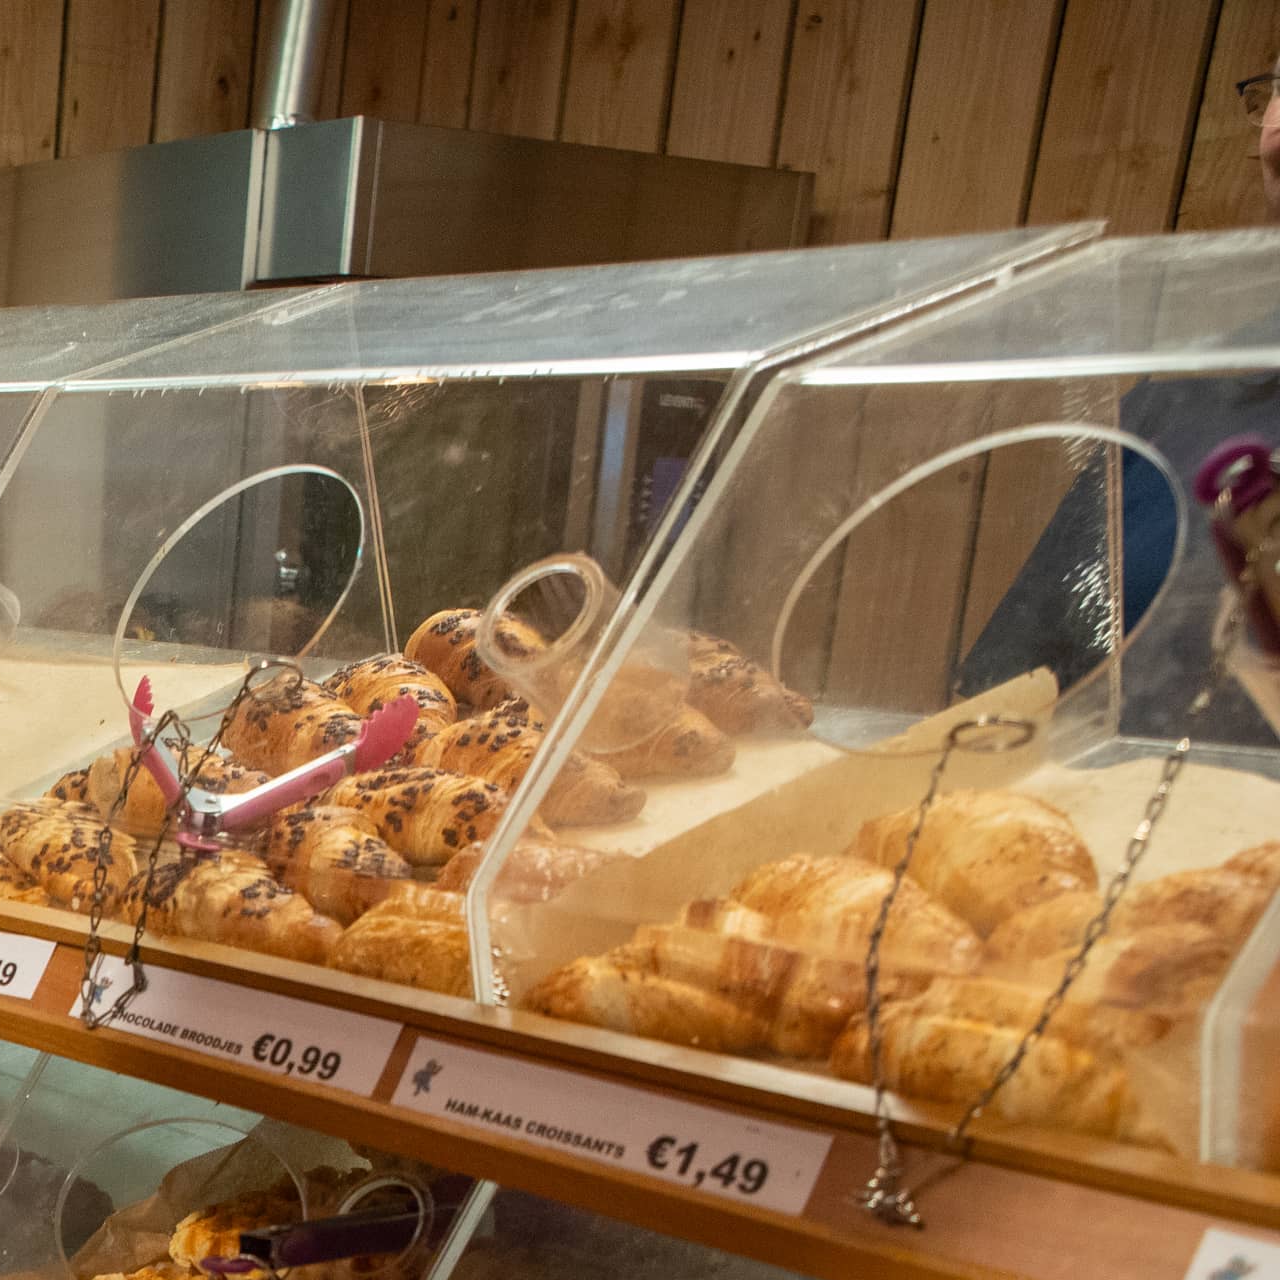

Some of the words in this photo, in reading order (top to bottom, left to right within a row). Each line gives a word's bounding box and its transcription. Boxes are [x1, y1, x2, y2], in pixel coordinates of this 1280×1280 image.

[180, 1028, 243, 1056] BROODJES
[251, 1033, 342, 1081] €0,99
[444, 1098, 524, 1131] HAM-KAAS
[525, 1119, 626, 1160] CROISSANTS
[645, 1135, 769, 1195] €1,49
